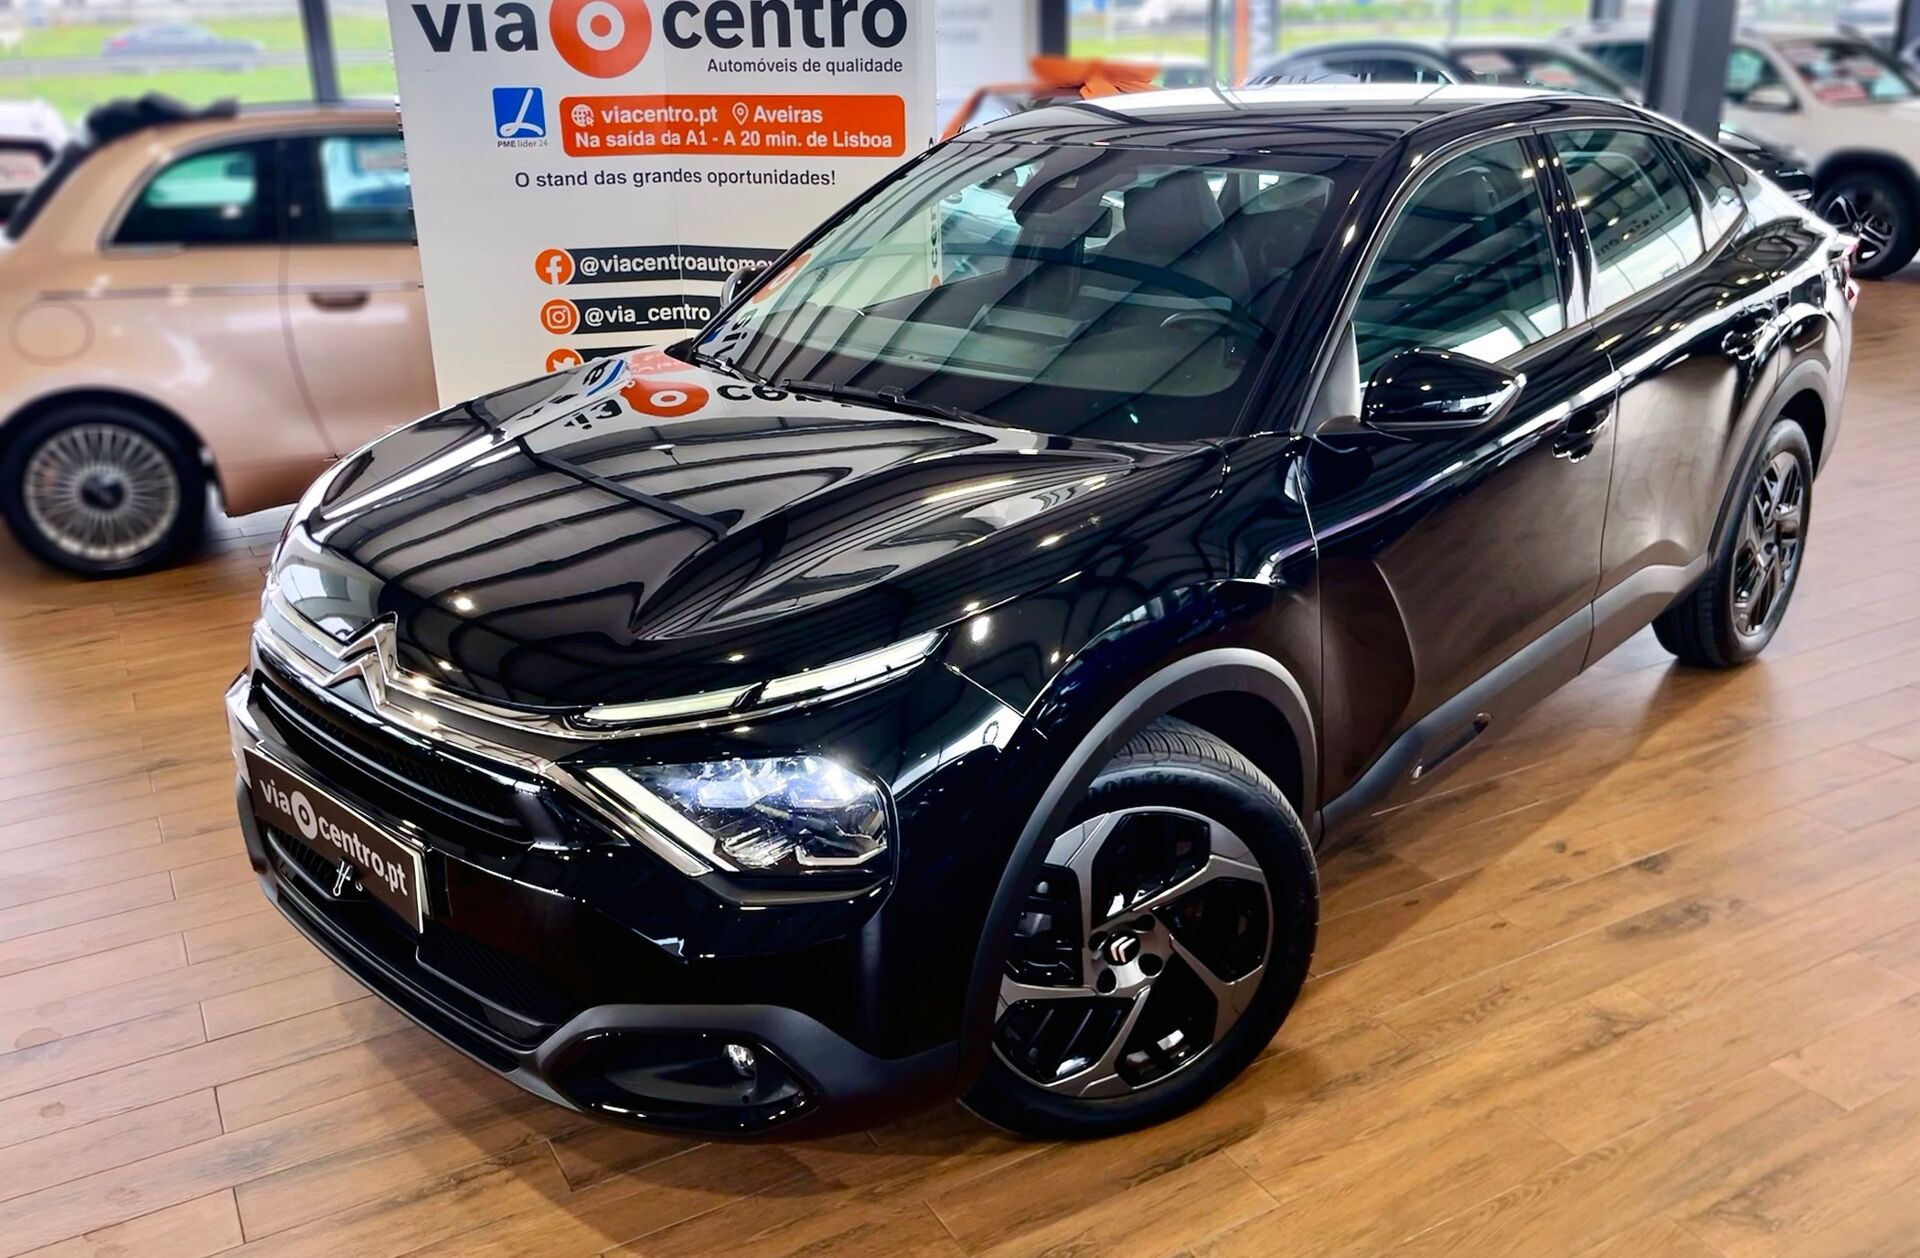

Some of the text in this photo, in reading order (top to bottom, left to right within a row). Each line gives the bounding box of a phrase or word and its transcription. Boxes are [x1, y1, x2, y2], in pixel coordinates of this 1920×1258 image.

[411, 0, 907, 52] via centro
[707, 58, 903, 76] Automóveis de qualidade
[601, 105, 823, 126] viacentro.pt Aveiras
[497, 140, 516, 148] PME
[575, 132, 600, 148] Na
[605, 130, 656, 147] saída
[661, 130, 681, 146] da
[685, 130, 708, 146] A1
[723, 131, 736, 146] A
[740, 131, 761, 147] 20
[766, 131, 802, 147] min.
[806, 131, 828, 147] de
[833, 131, 892, 148] Lisboa
[515, 168, 836, 188] O stand das grandes oportunidades!
[584, 303, 711, 327] @via_centro
[259, 779, 408, 896] via centro.pt
